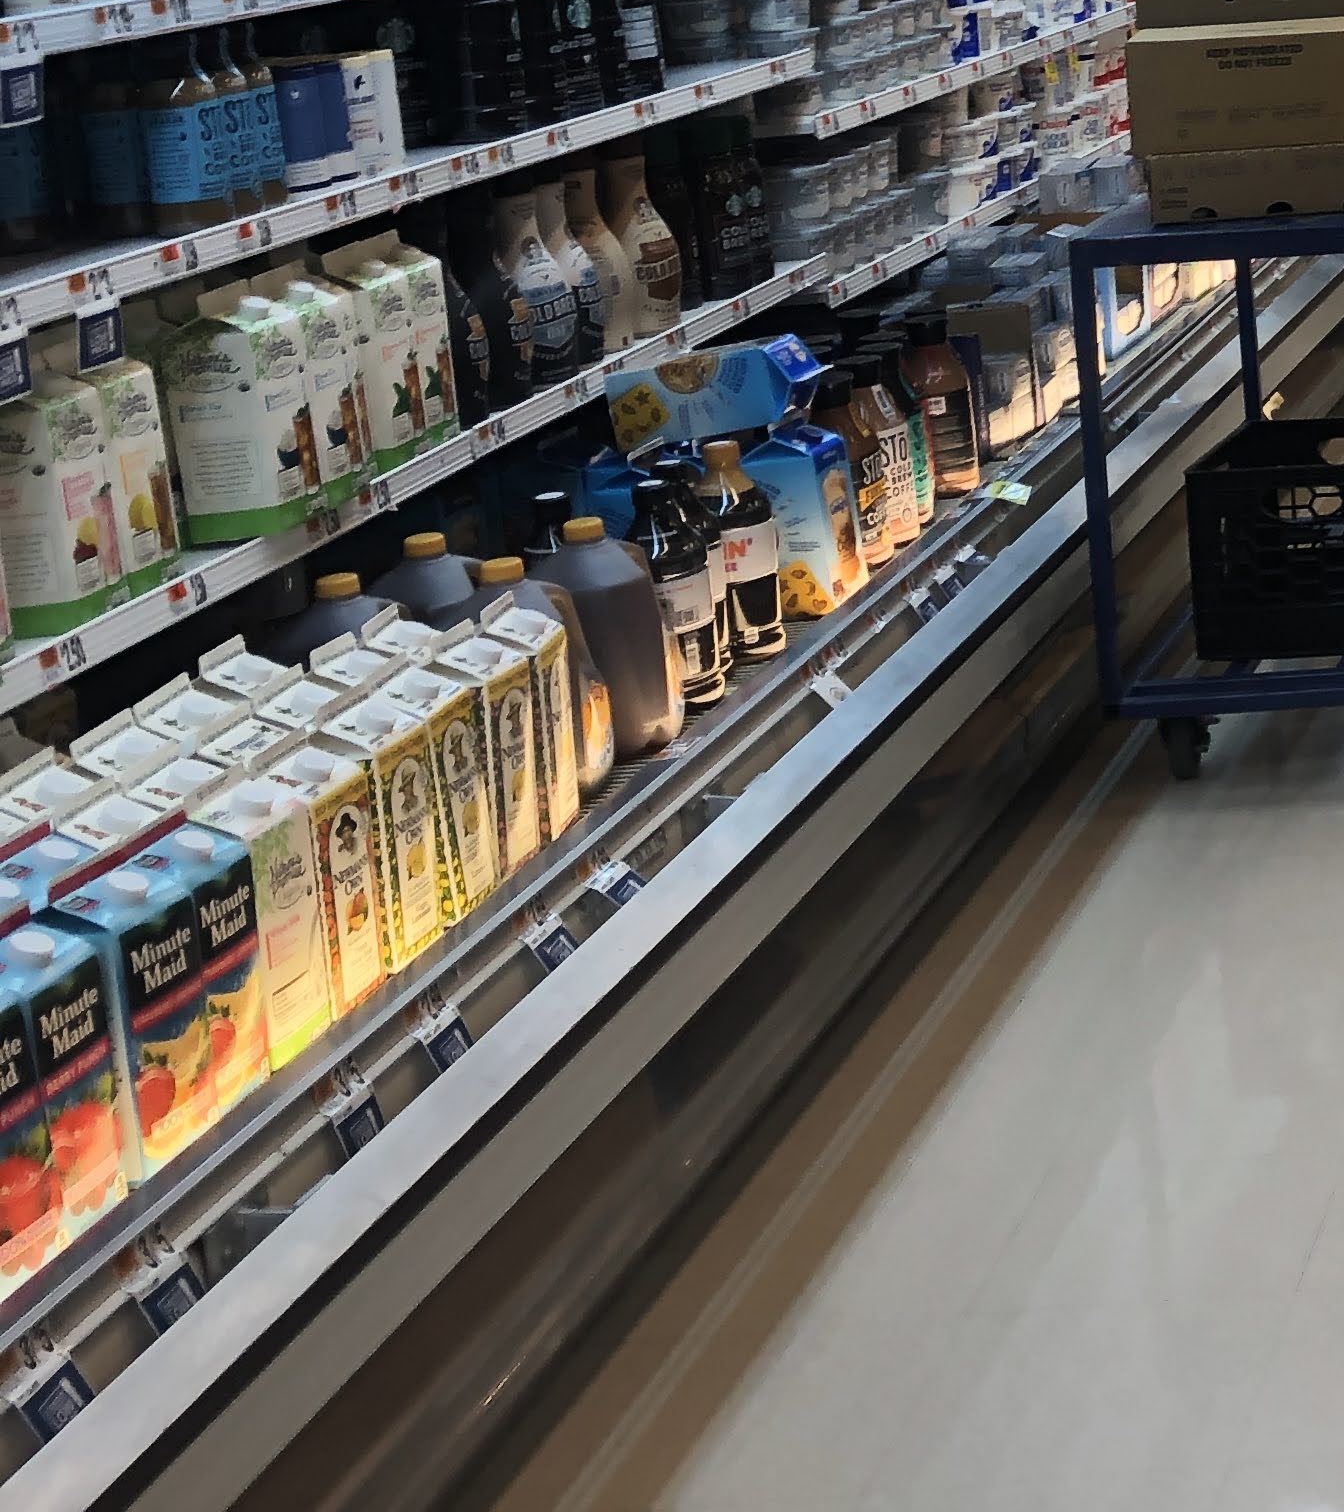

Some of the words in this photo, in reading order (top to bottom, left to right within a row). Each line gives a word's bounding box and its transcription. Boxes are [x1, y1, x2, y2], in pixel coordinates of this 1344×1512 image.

[1218, 59, 1232, 70] DO
[1235, 58, 1254, 69] NOT
[200, 884, 250, 929] Minute
[211, 907, 247, 948] Maid
[129, 925, 192, 974] Minute
[143, 949, 188, 994] Maid
[38, 987, 98, 1039] Minute
[52, 1010, 95, 1060] Maid
